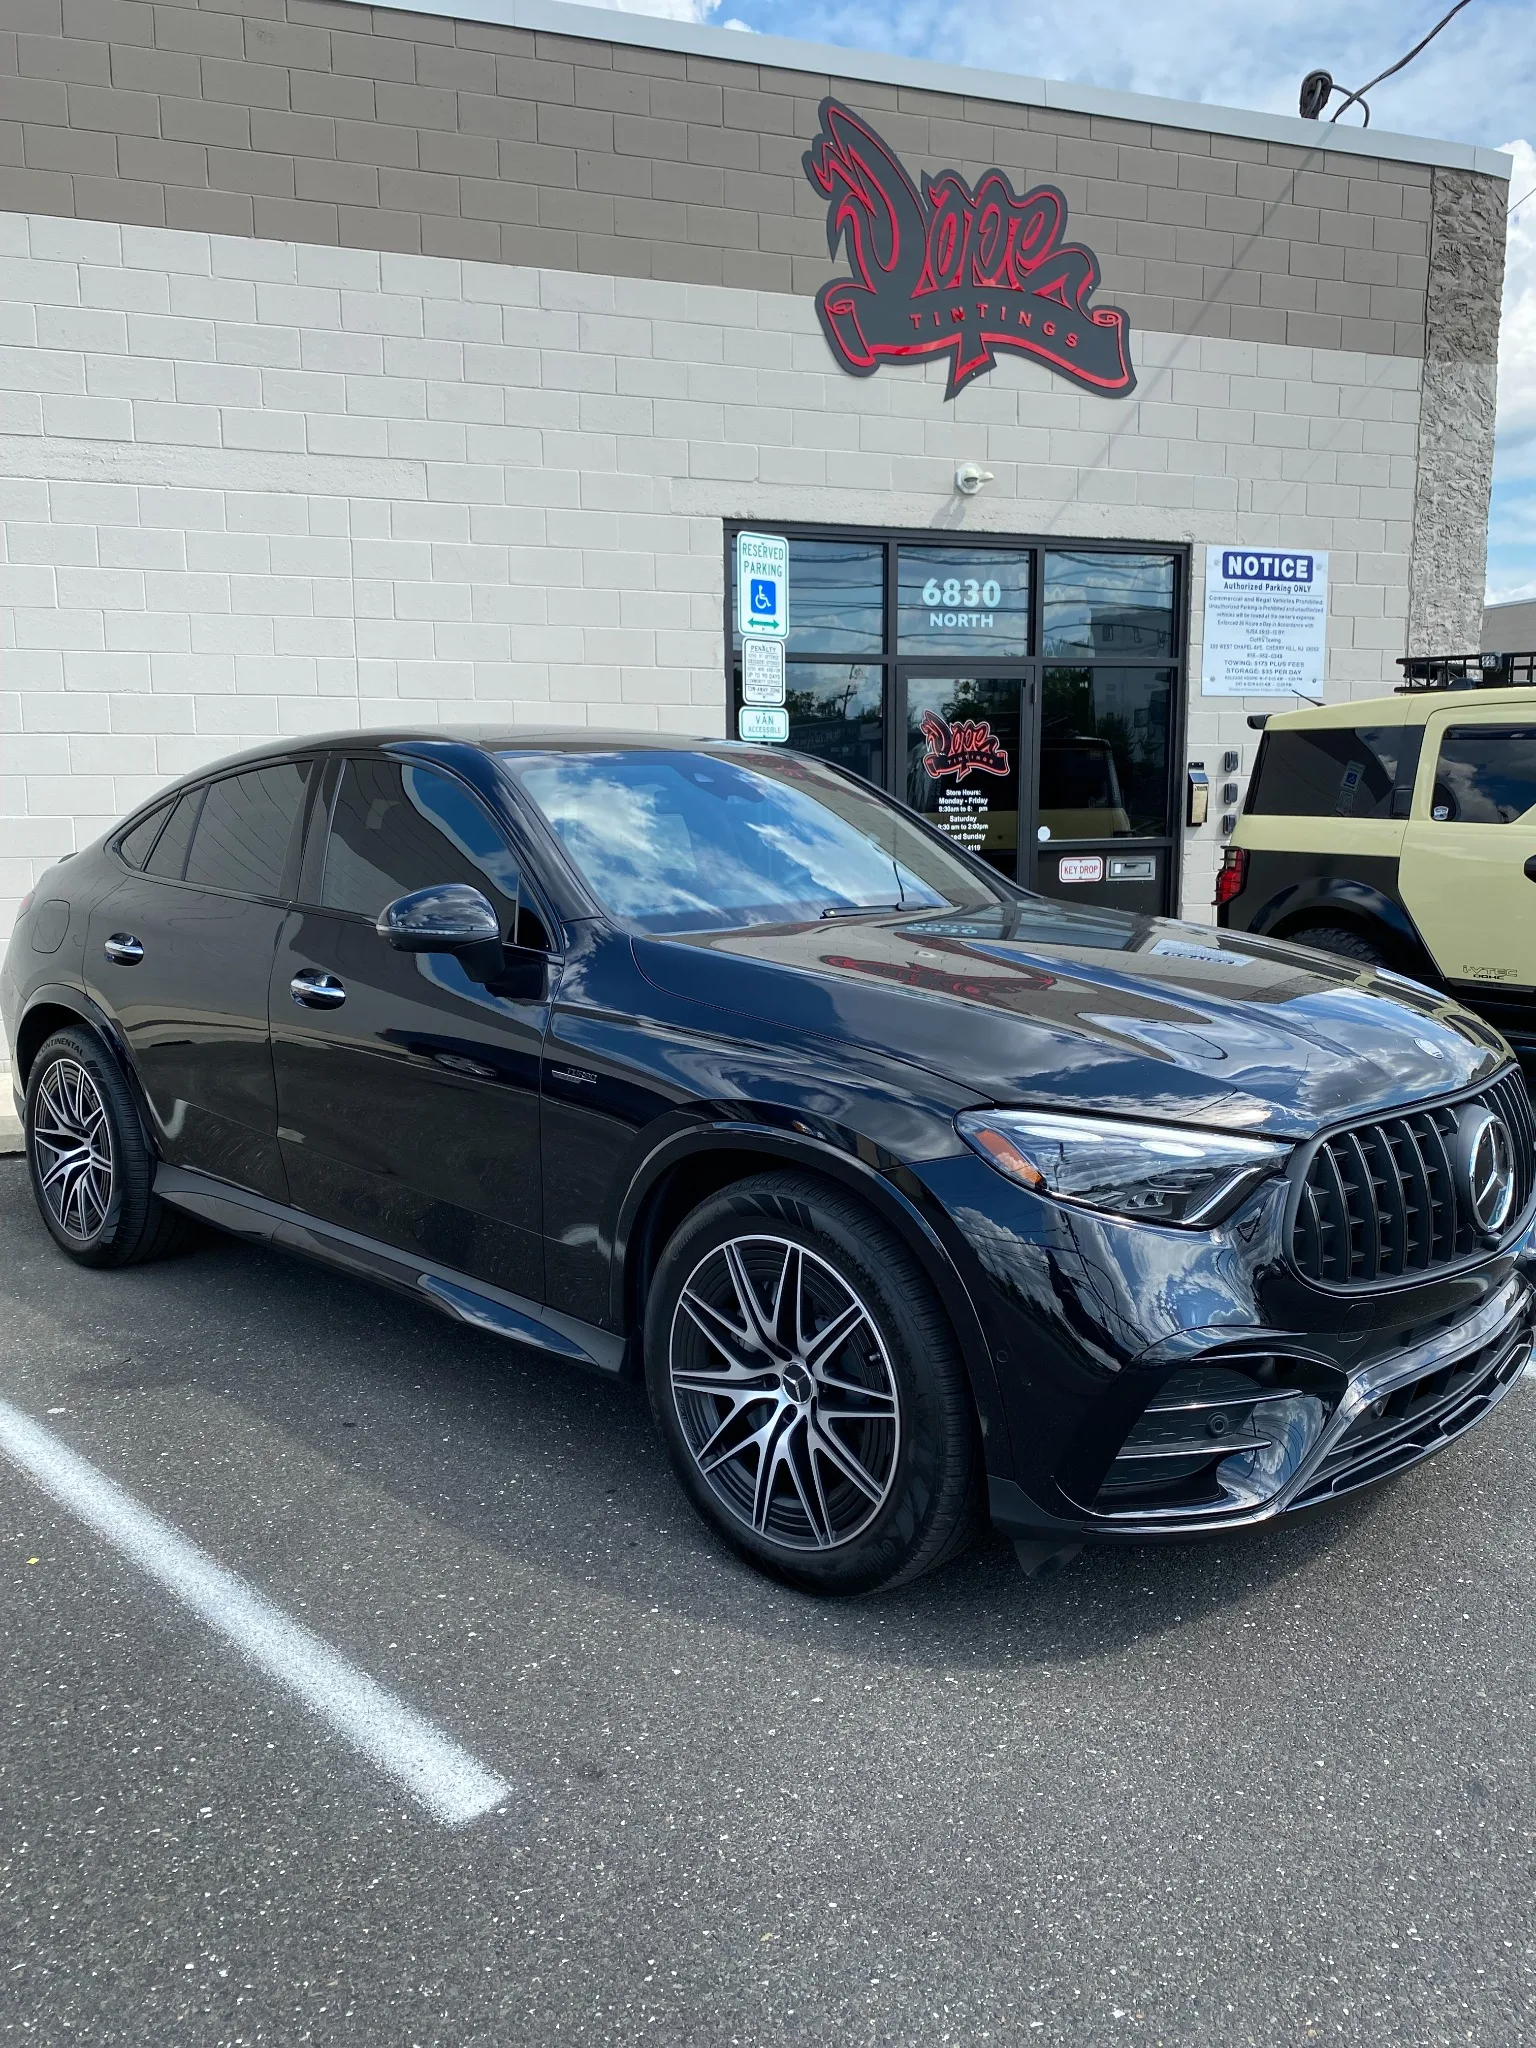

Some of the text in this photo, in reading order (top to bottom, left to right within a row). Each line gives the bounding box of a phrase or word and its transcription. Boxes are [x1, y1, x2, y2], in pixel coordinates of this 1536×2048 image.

[909, 302, 1079, 348] TINTINGS
[742, 543, 784, 561] RESERVED
[743, 561, 783, 577] PARKING
[1228, 556, 1309, 578] NOTICE
[922, 578, 1001, 607] 6830
[1224, 582, 1312, 594] Authorized Parking ONLY
[929, 612, 994, 627] NORTH
[750, 645, 777, 653] PENALTY
[755, 714, 774, 725] VAN
[748, 726, 782, 734] ACCESSIBLE
[947, 754, 993, 765] TINTINGS
[938, 797, 963, 805] Monday
[968, 796, 989, 805] Friday
[949, 815, 977, 823] Saturday
[962, 832, 986, 841] Sunday
[1064, 865, 1098, 874] KEY DROP
